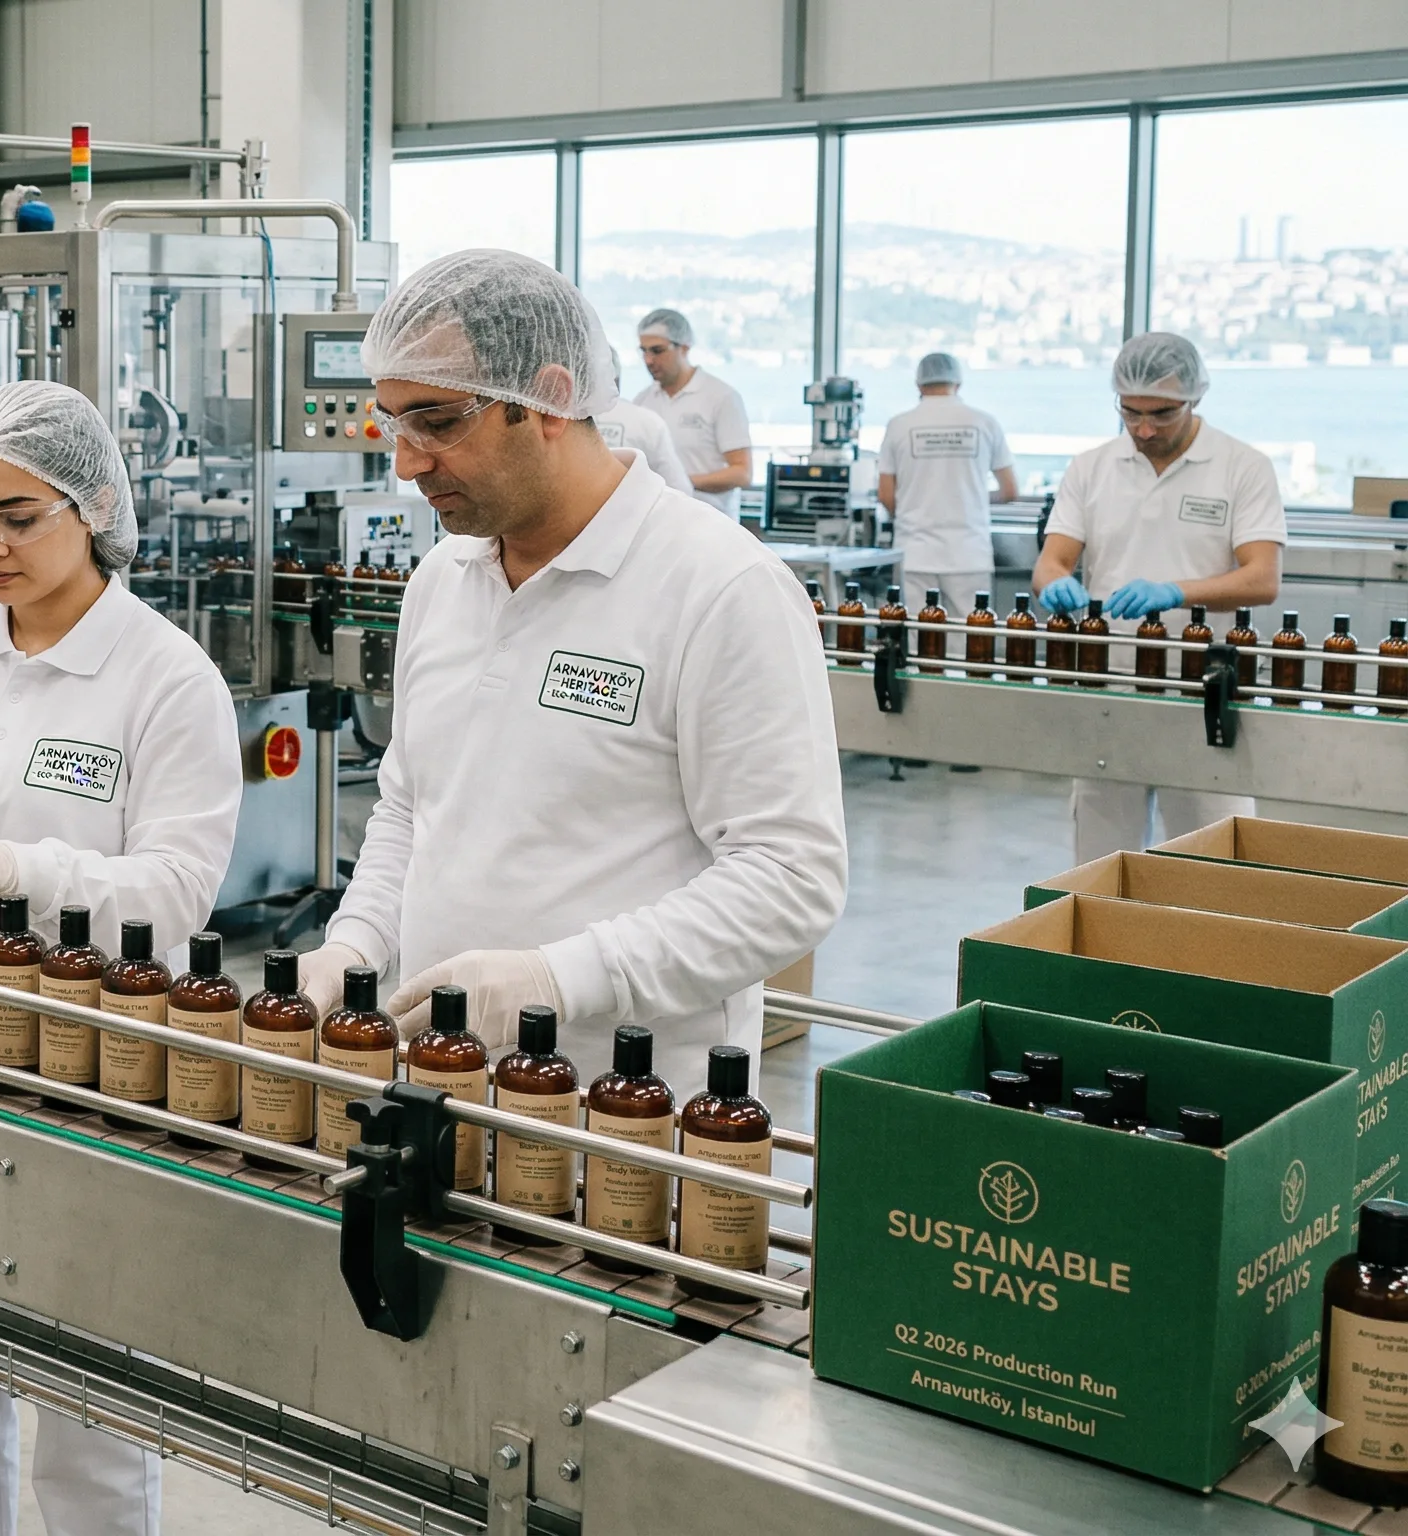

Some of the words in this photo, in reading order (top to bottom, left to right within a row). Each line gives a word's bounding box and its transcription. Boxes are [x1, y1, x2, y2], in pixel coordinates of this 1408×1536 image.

[553, 662, 636, 688] ARNAVUTKÖY
[38, 748, 116, 769] ARNAVUTKÖY
[1357, 1052, 1408, 1105] TAINABLE
[888, 1209, 1131, 1293] SUSTAINABLE
[1236, 1203, 1341, 1296] SUSTAINABLE
[952, 1261, 1059, 1311] STAYS
[1265, 1260, 1312, 1315] STAYS
[894, 1323, 919, 1345] Q2
[923, 1331, 968, 1358] 2026
[972, 1344, 1074, 1388] Production
[1079, 1373, 1117, 1400] Run
[910, 1369, 1016, 1417] Arnavutköy,
